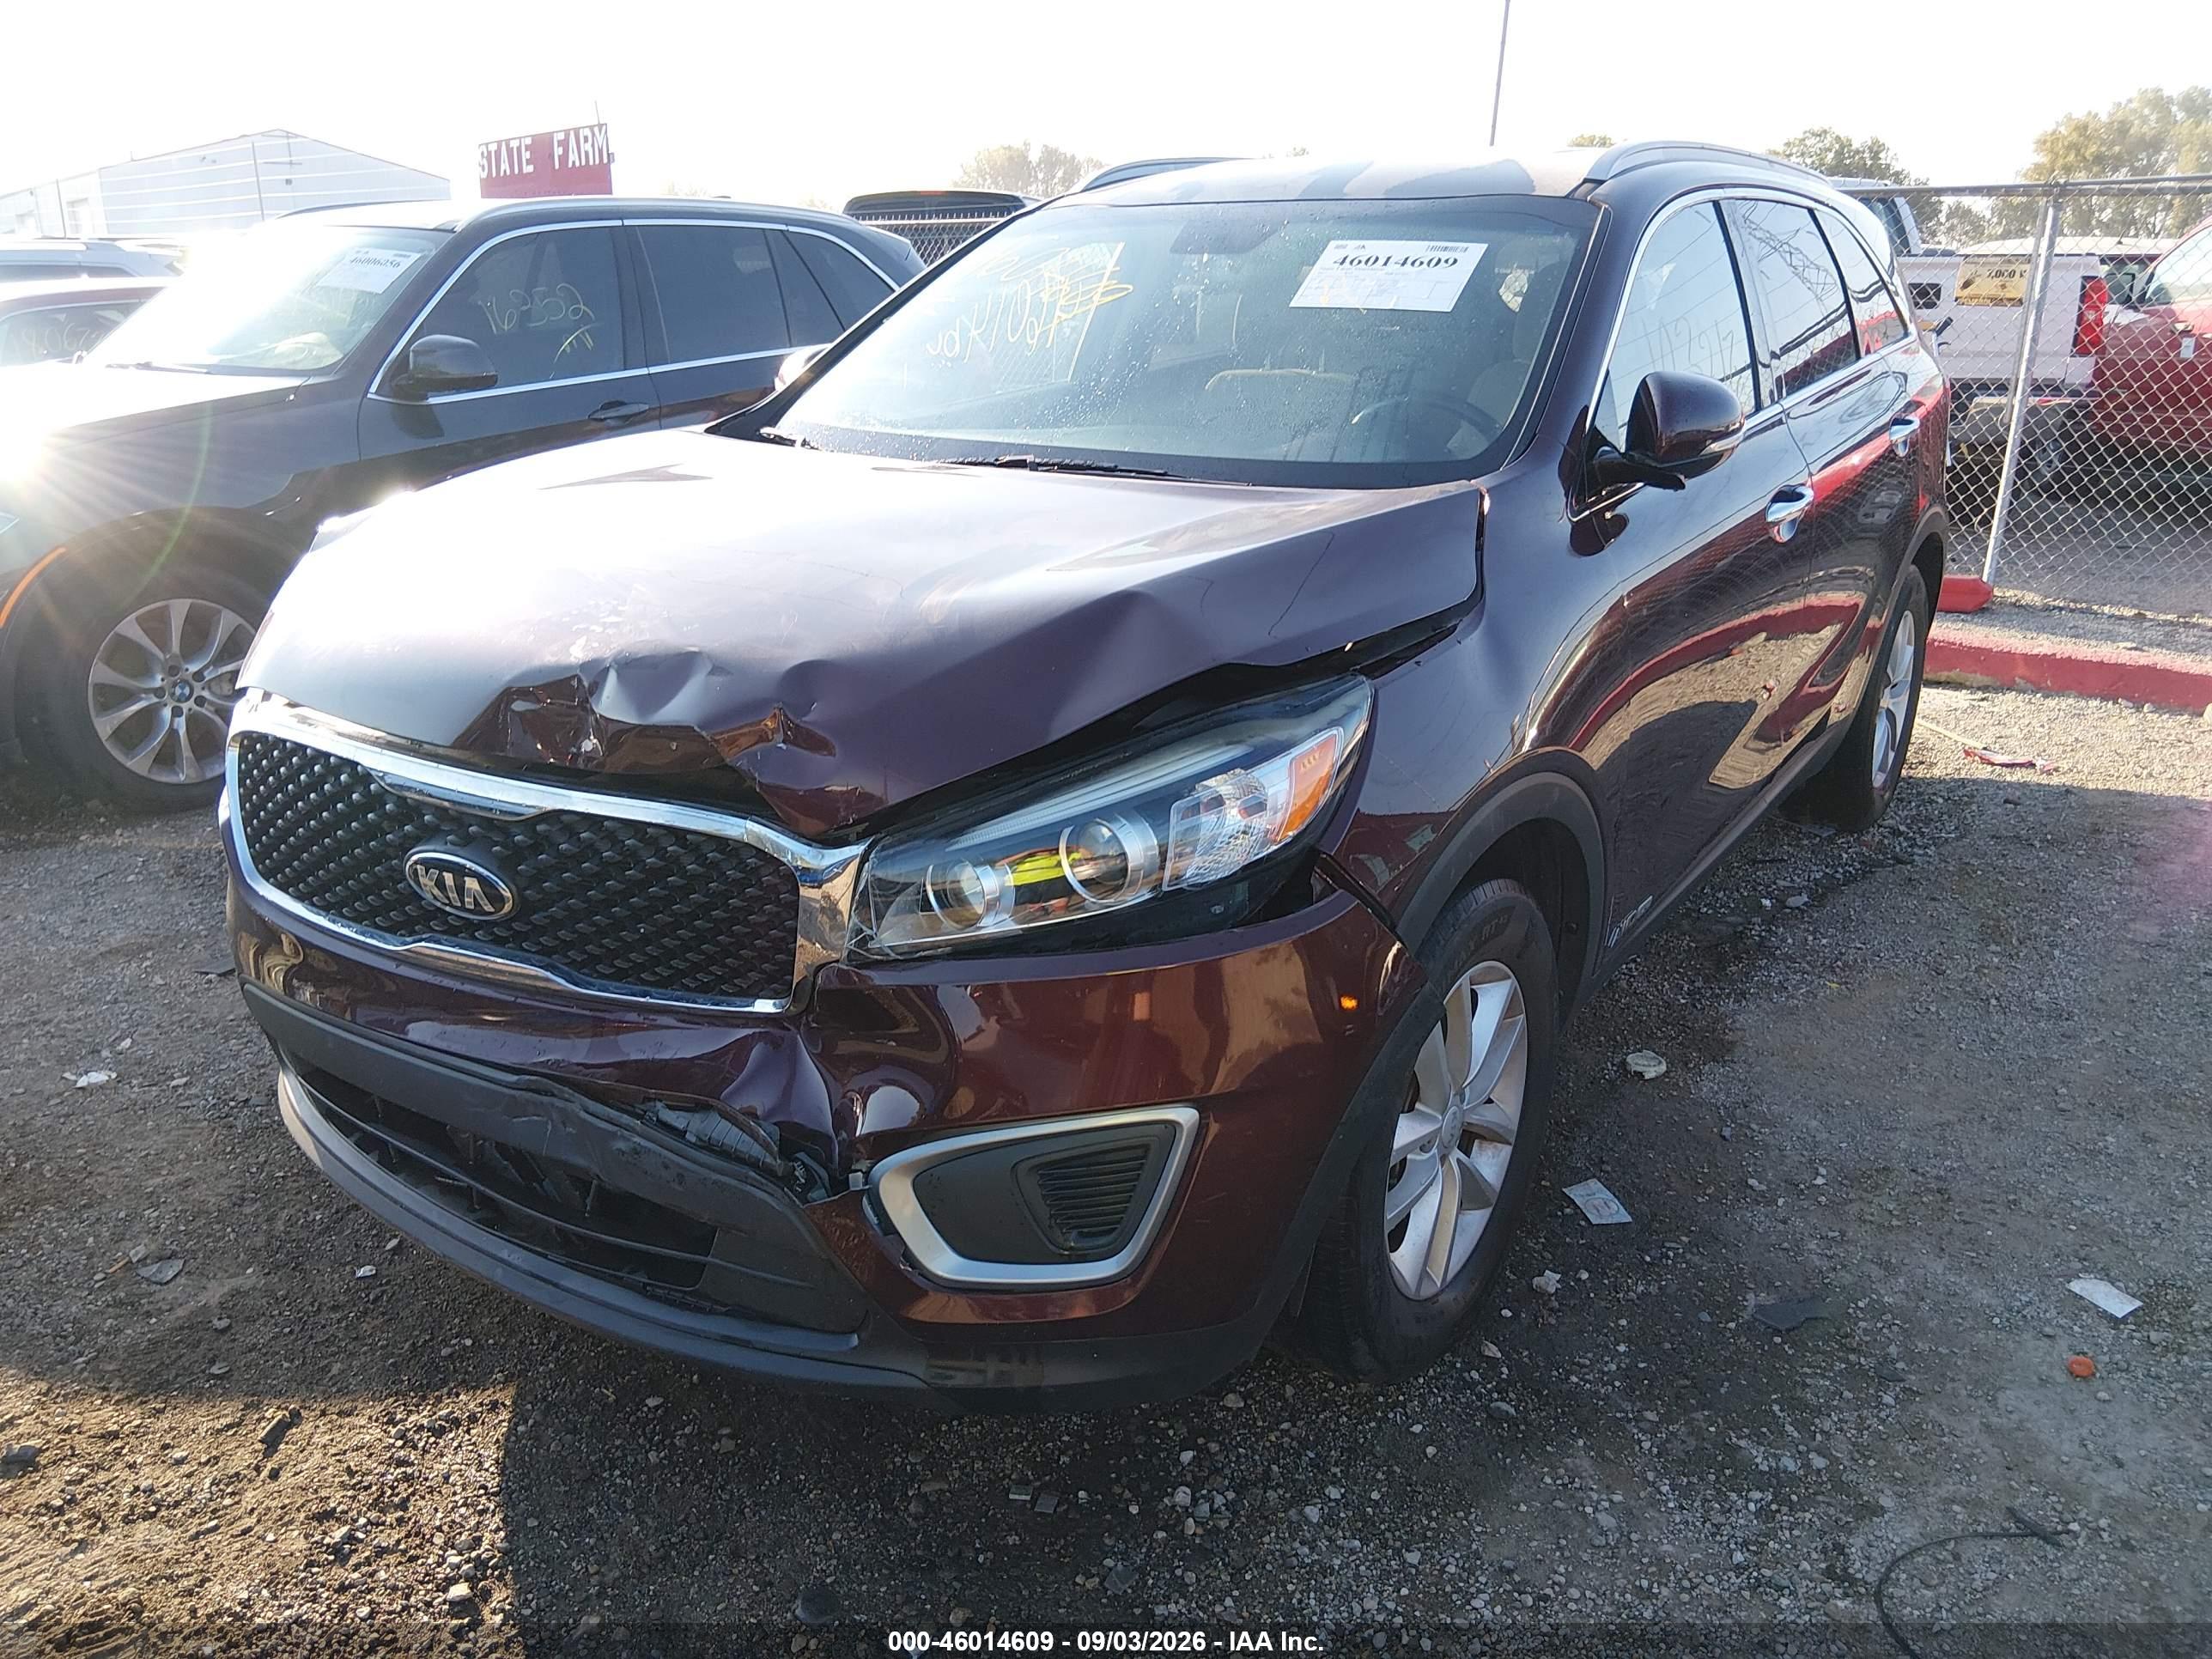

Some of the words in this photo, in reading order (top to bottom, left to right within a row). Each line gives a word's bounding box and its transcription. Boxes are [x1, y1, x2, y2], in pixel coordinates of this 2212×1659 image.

[477, 137, 534, 179] STATE
[553, 125, 610, 170] FARM
[1332, 254, 1460, 270] 46014609
[416, 864, 495, 913] KIA
